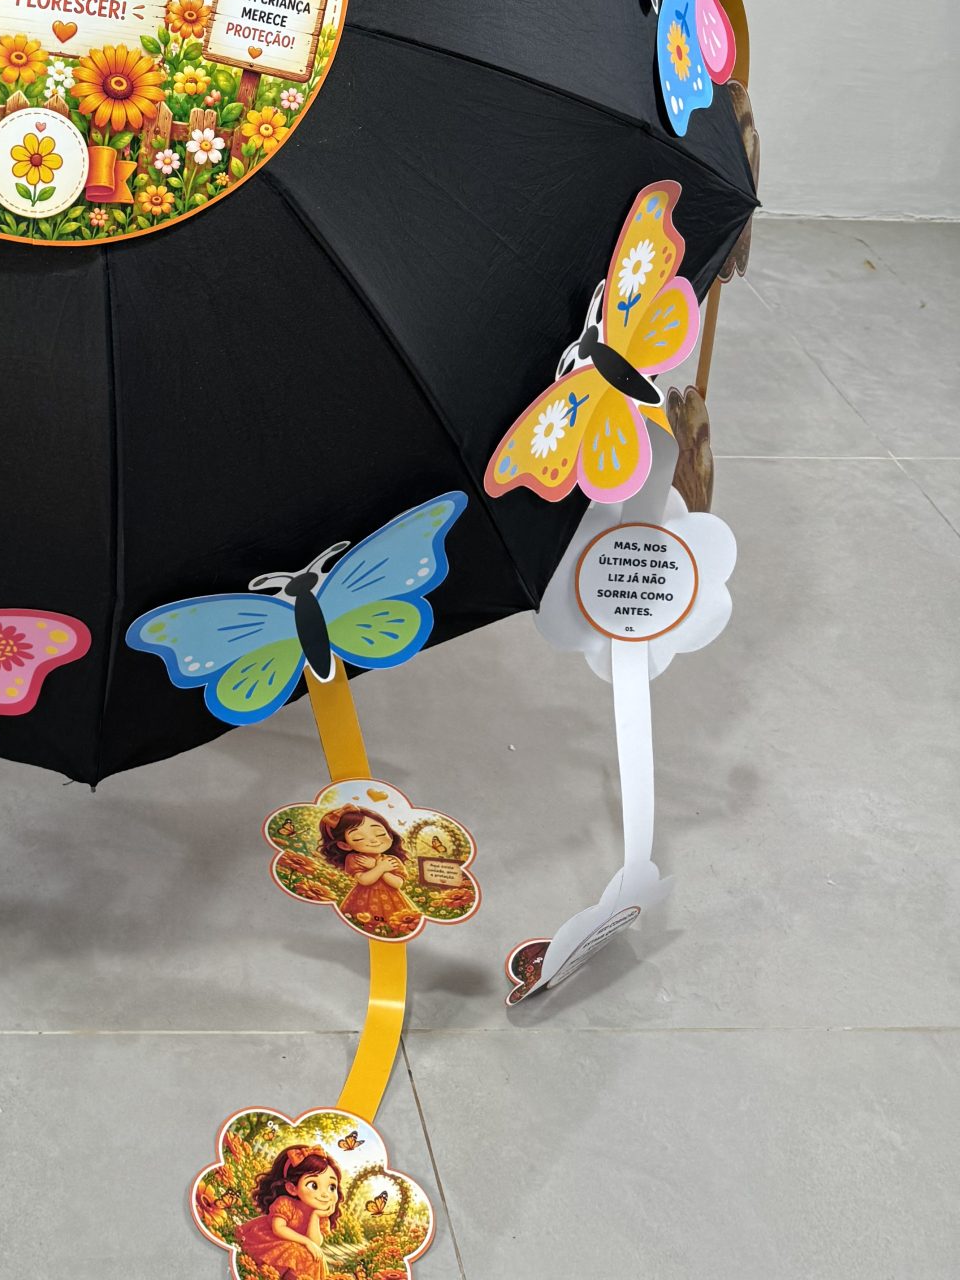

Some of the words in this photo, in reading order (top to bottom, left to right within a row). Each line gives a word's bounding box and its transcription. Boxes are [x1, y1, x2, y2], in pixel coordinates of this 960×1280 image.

[241, 6, 288, 29] MERECE
[226, 21, 295, 50] PROTEÇÃO!
[613, 541, 641, 552] MAS,
[643, 543, 667, 553] NOS
[598, 554, 648, 568] ÚLTIMOS
[650, 559, 679, 571] DIAS,
[608, 573, 625, 583] LIZ
[627, 572, 640, 584] JÁ
[642, 573, 666, 585] NÃO
[597, 589, 638, 600] SORRIA
[640, 591, 674, 602] COMO
[614, 606, 653, 617] ANTES.
